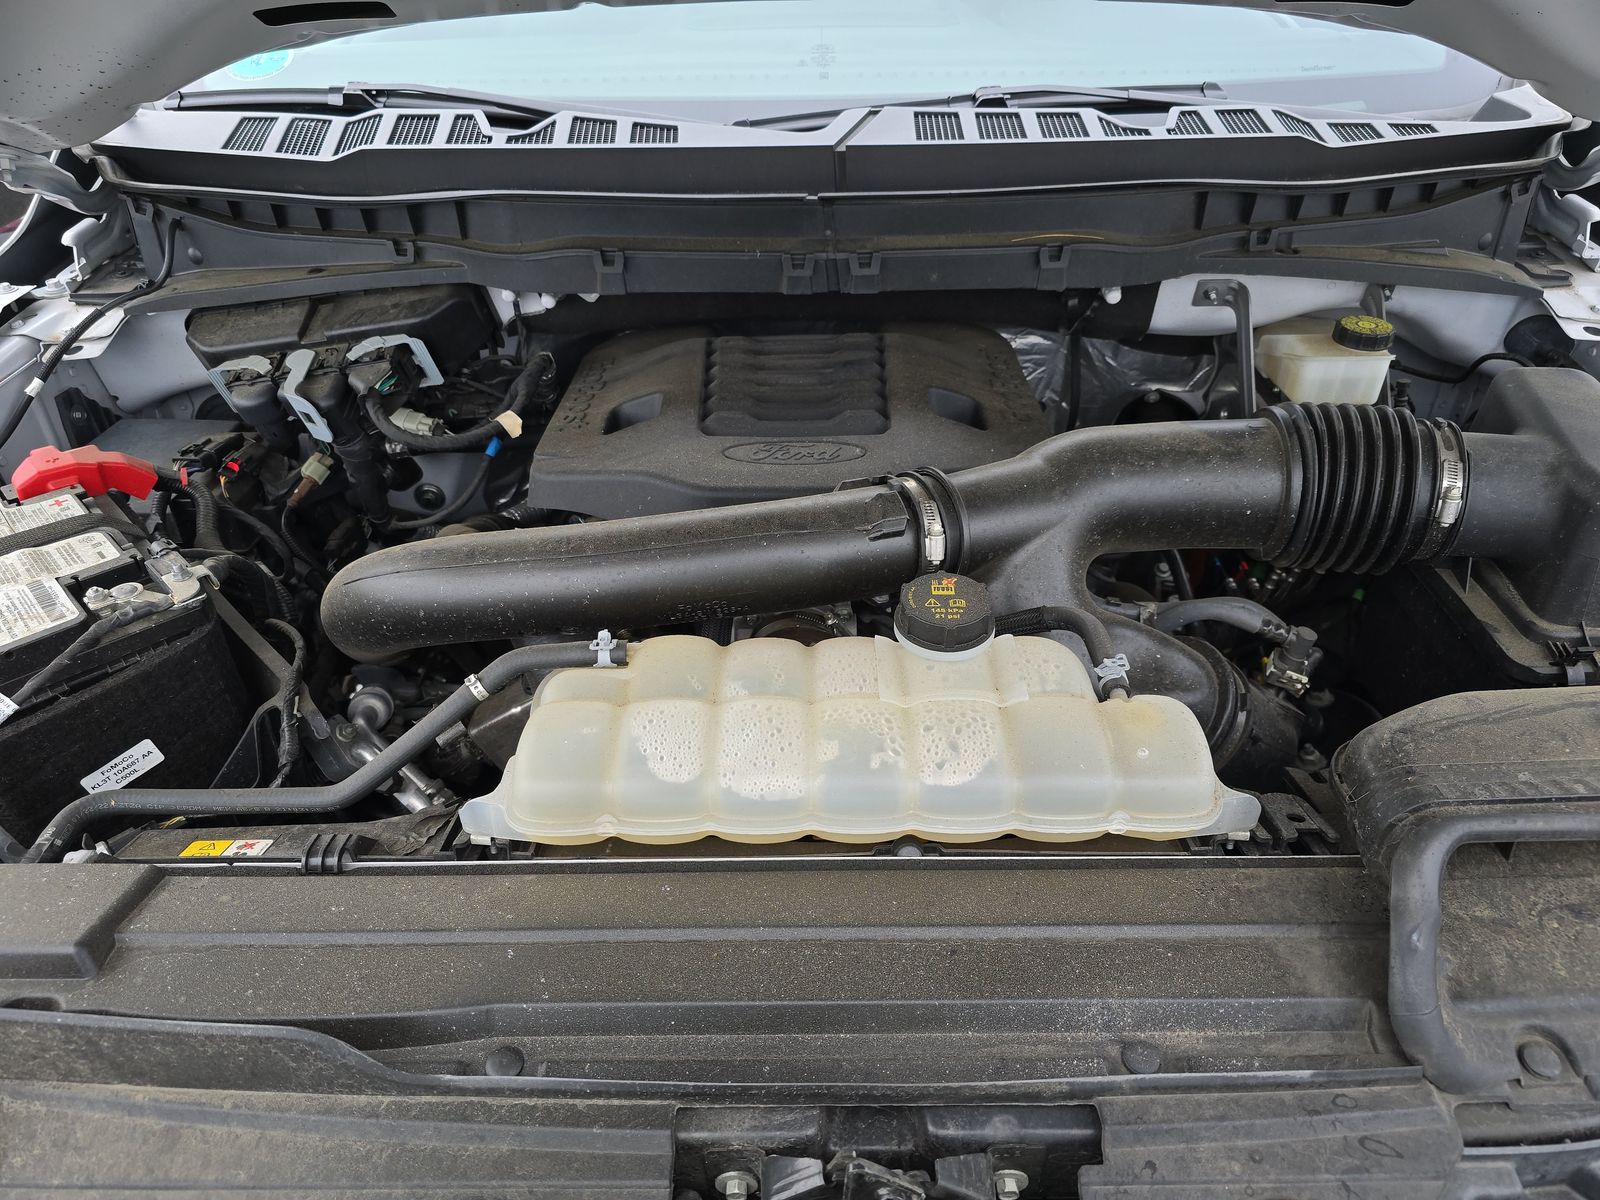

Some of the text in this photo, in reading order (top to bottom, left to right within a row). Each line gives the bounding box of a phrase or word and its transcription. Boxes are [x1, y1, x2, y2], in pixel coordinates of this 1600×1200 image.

[752, 443, 842, 461] Ford
[90, 750, 154, 791] KL3T 10A687 AA
[100, 754, 134, 777] FoMoCo
[115, 769, 140, 785] C500L
